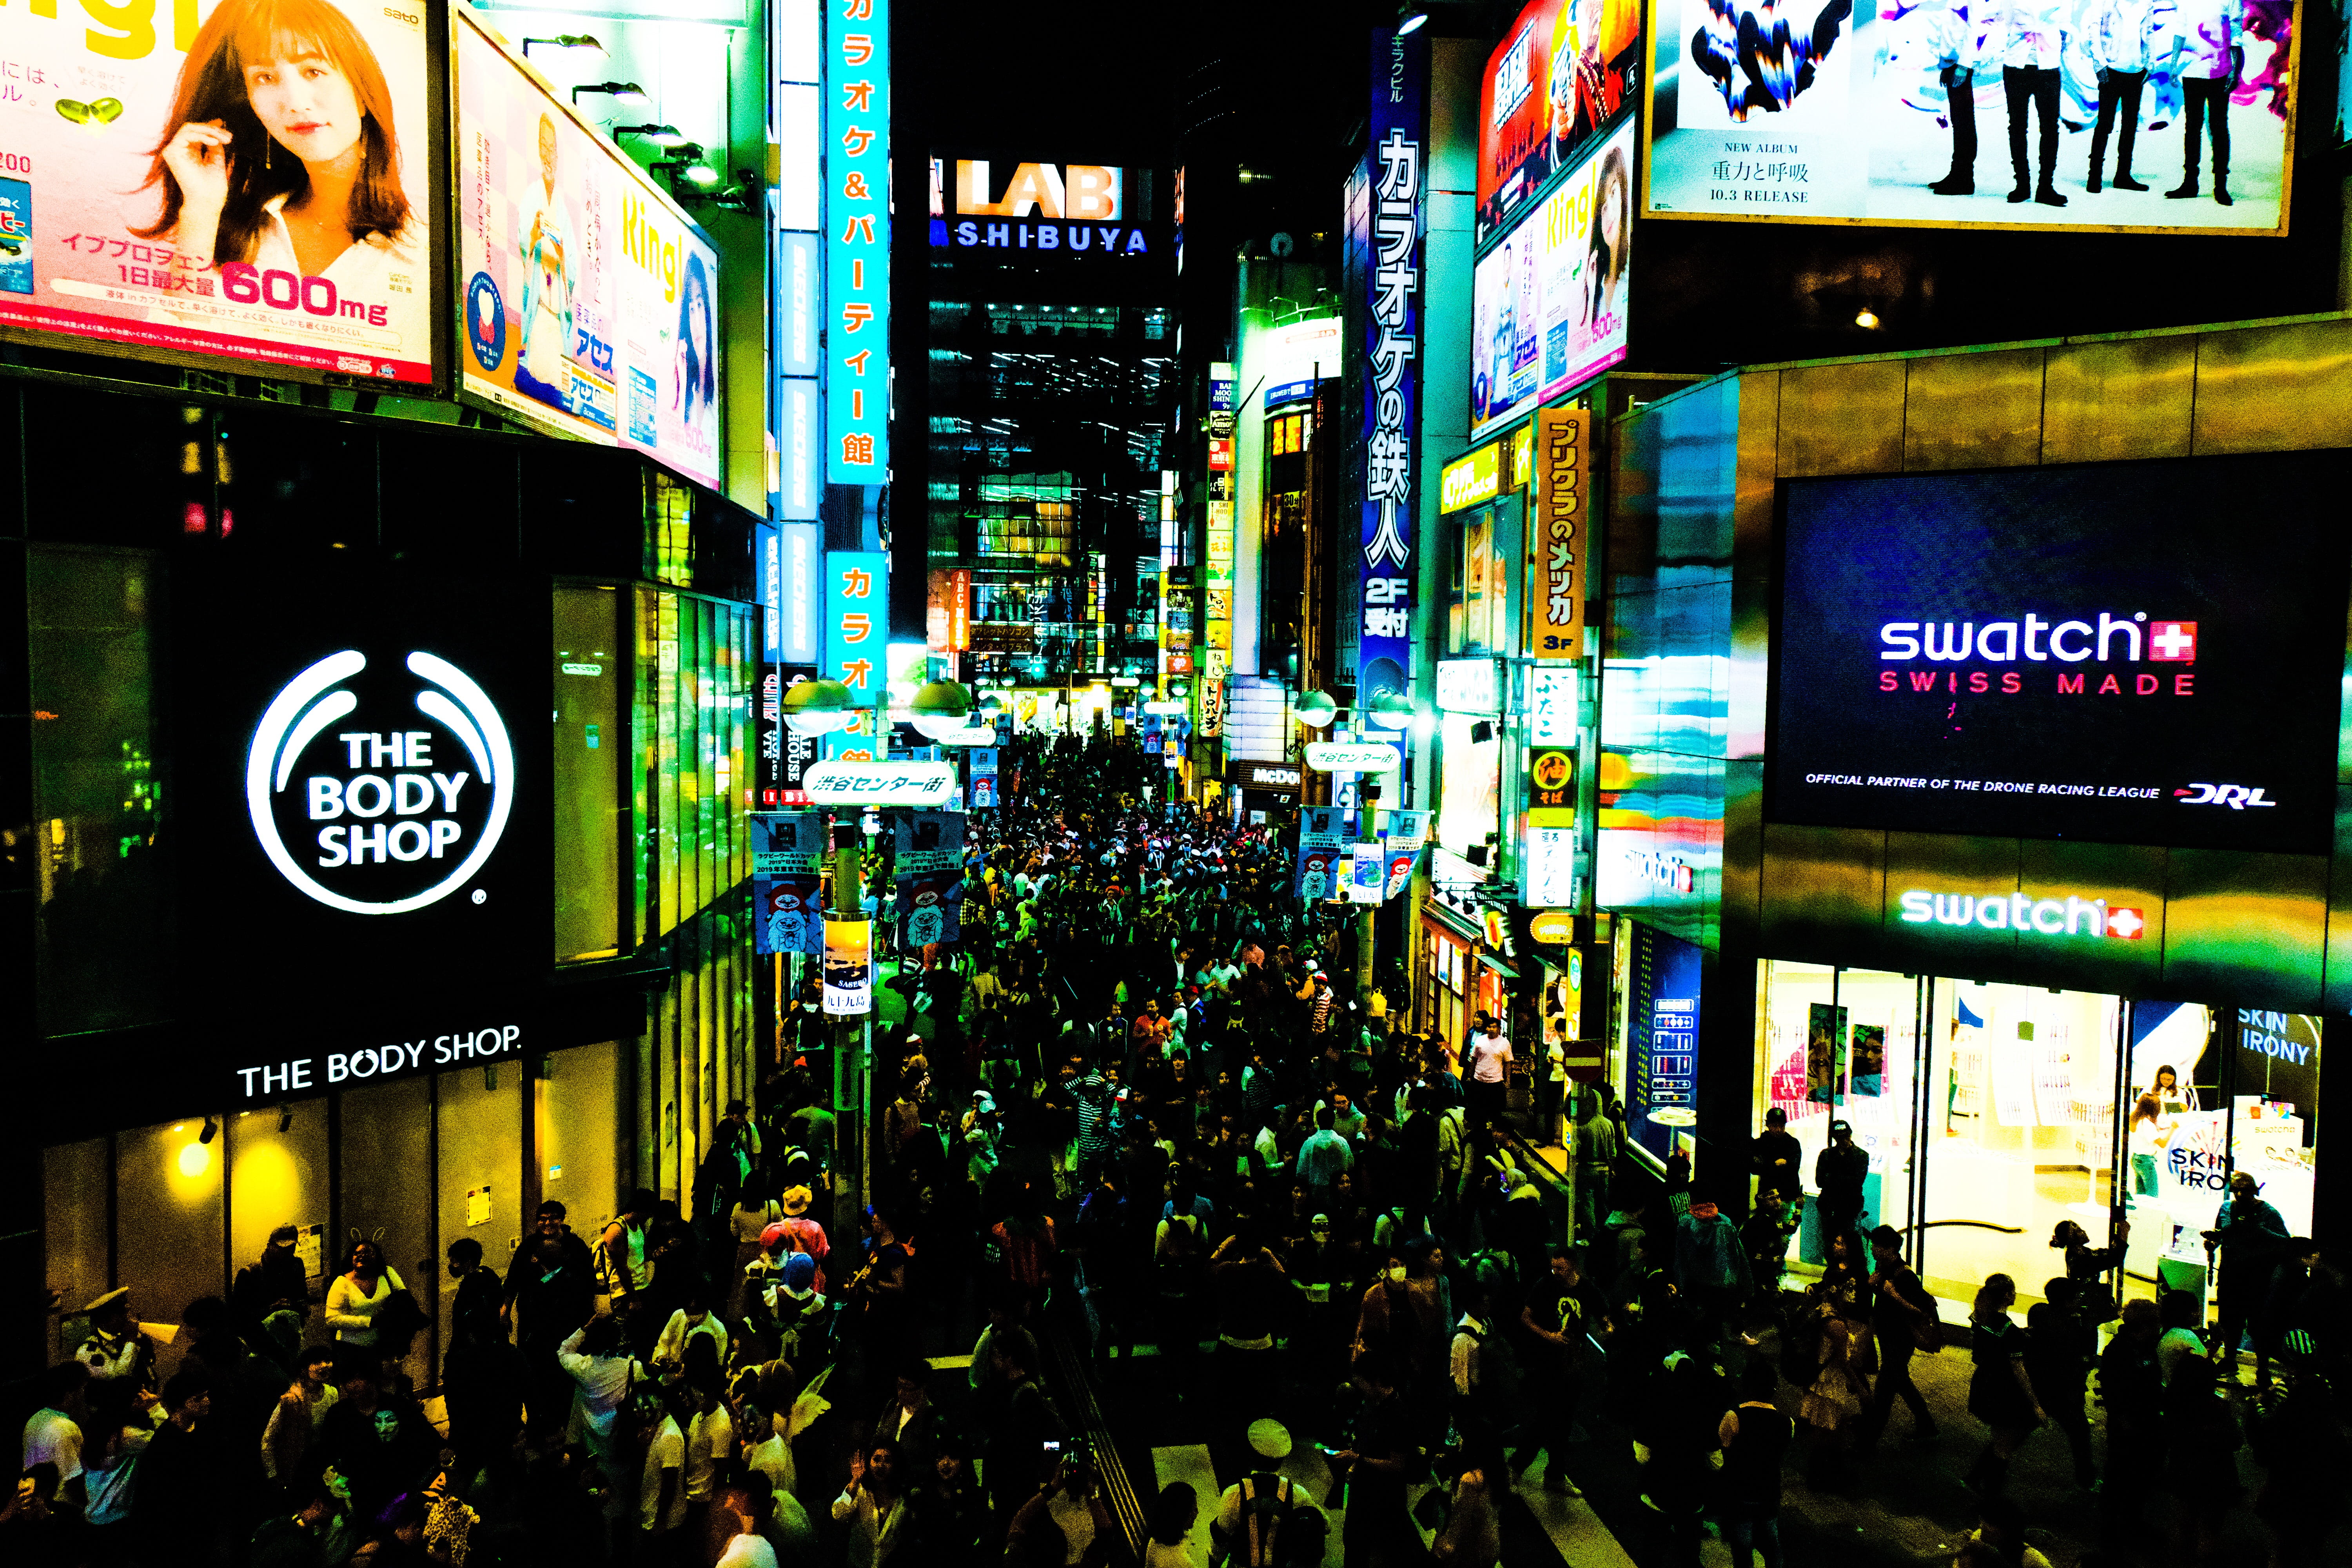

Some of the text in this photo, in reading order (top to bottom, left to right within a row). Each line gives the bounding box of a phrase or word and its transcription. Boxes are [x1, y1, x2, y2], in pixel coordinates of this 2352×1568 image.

[384, 7, 418, 24] sato
[0, 152, 31, 173] 00
[1724, 143, 1798, 154] NEW ALBUM
[1711, 160, 1808, 183] 重力と呼吸
[956, 159, 1122, 220] LAB
[1710, 189, 1808, 203] 10.3 RELEASE
[957, 221, 1148, 252] SHIBUYA
[118, 265, 216, 297] 1日最大量
[793, 244, 806, 364] SKECHERS
[1365, 127, 1419, 570] カラオケの鉄人
[1515, 334, 1537, 367] アセス
[793, 390, 806, 508] SKECHERS
[1547, 419, 1578, 626] プリクラのメッカ
[793, 534, 806, 651] SKECHERS
[1365, 577, 1408, 603] 2F
[1364, 607, 1408, 638] 受付
[1881, 612, 2142, 661] swatch
[1543, 635, 1573, 651] 3F
[1211, 653, 1222, 676] ねぎし
[1879, 670, 2195, 696] SWISS MADE
[340, 732, 432, 768] THE
[788, 730, 800, 781] HOUSE
[1312, 752, 1396, 763] 渋谷センター街
[813, 776, 947, 792] 渋谷センター街
[1539, 757, 1566, 782] 油
[309, 772, 469, 820] BODY
[1806, 773, 2160, 799] OFFICIAL PARTNER OF THE DRONE RACING LEAGUE
[2180, 783, 2276, 809] DRL
[318, 820, 462, 867] SHOP
[1900, 890, 2104, 937] swatch
[838, 977, 867, 989] SASEBO
[2239, 1008, 2287, 1034] SKIN
[2243, 1028, 2310, 1066] IRONY
[237, 1059, 312, 1097] THE
[328, 1040, 426, 1082] BODY
